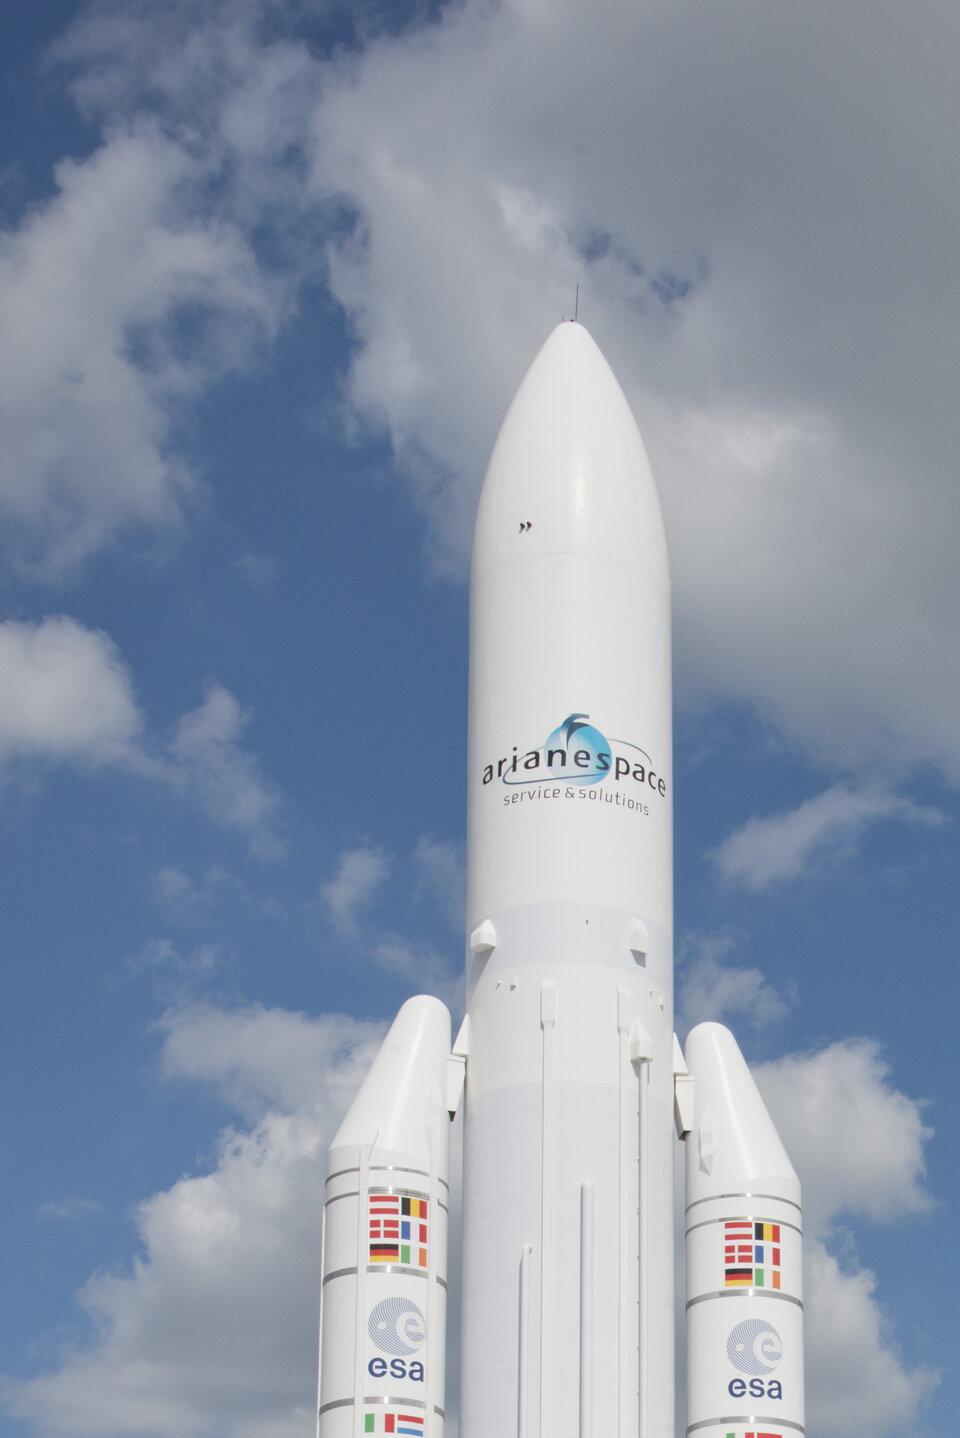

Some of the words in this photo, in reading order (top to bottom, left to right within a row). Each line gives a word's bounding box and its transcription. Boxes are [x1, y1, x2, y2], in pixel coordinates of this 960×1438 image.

[482, 747, 666, 797] arianespace
[503, 786, 561, 806] service
[565, 787, 575, 799] &
[579, 788, 649, 816] solutions
[368, 1357, 424, 1382] esa
[728, 1378, 782, 1400] esa
